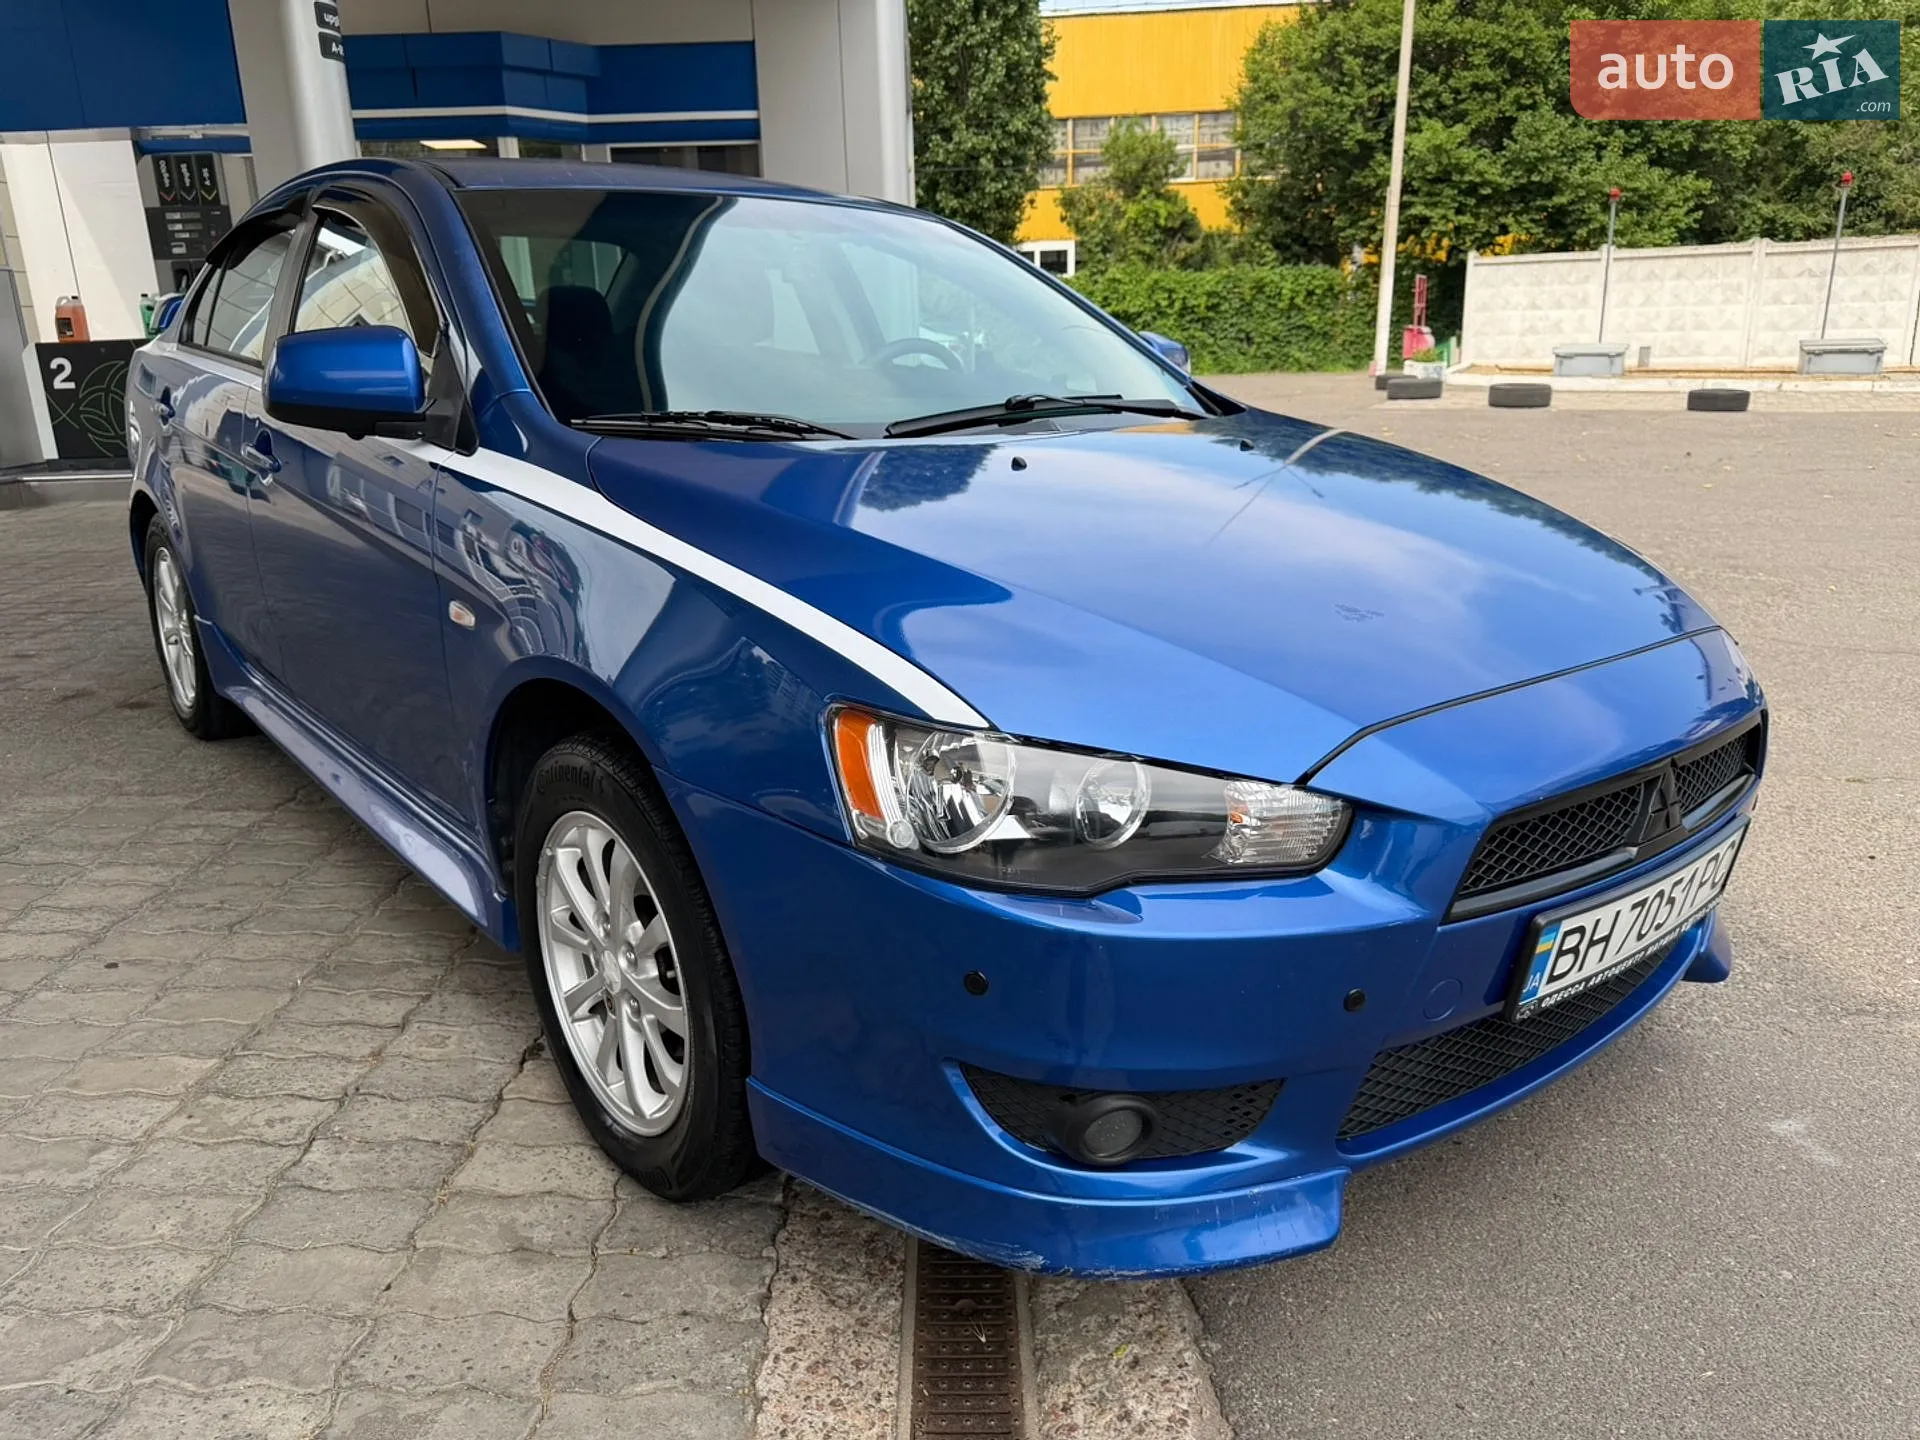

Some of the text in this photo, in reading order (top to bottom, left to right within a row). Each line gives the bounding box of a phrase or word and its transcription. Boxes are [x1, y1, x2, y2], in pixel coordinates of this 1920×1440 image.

[50, 357, 76, 389] 2
[1546, 909, 1621, 986] BH
[1616, 867, 1700, 955] 7051
[1690, 839, 1736, 909] PC
